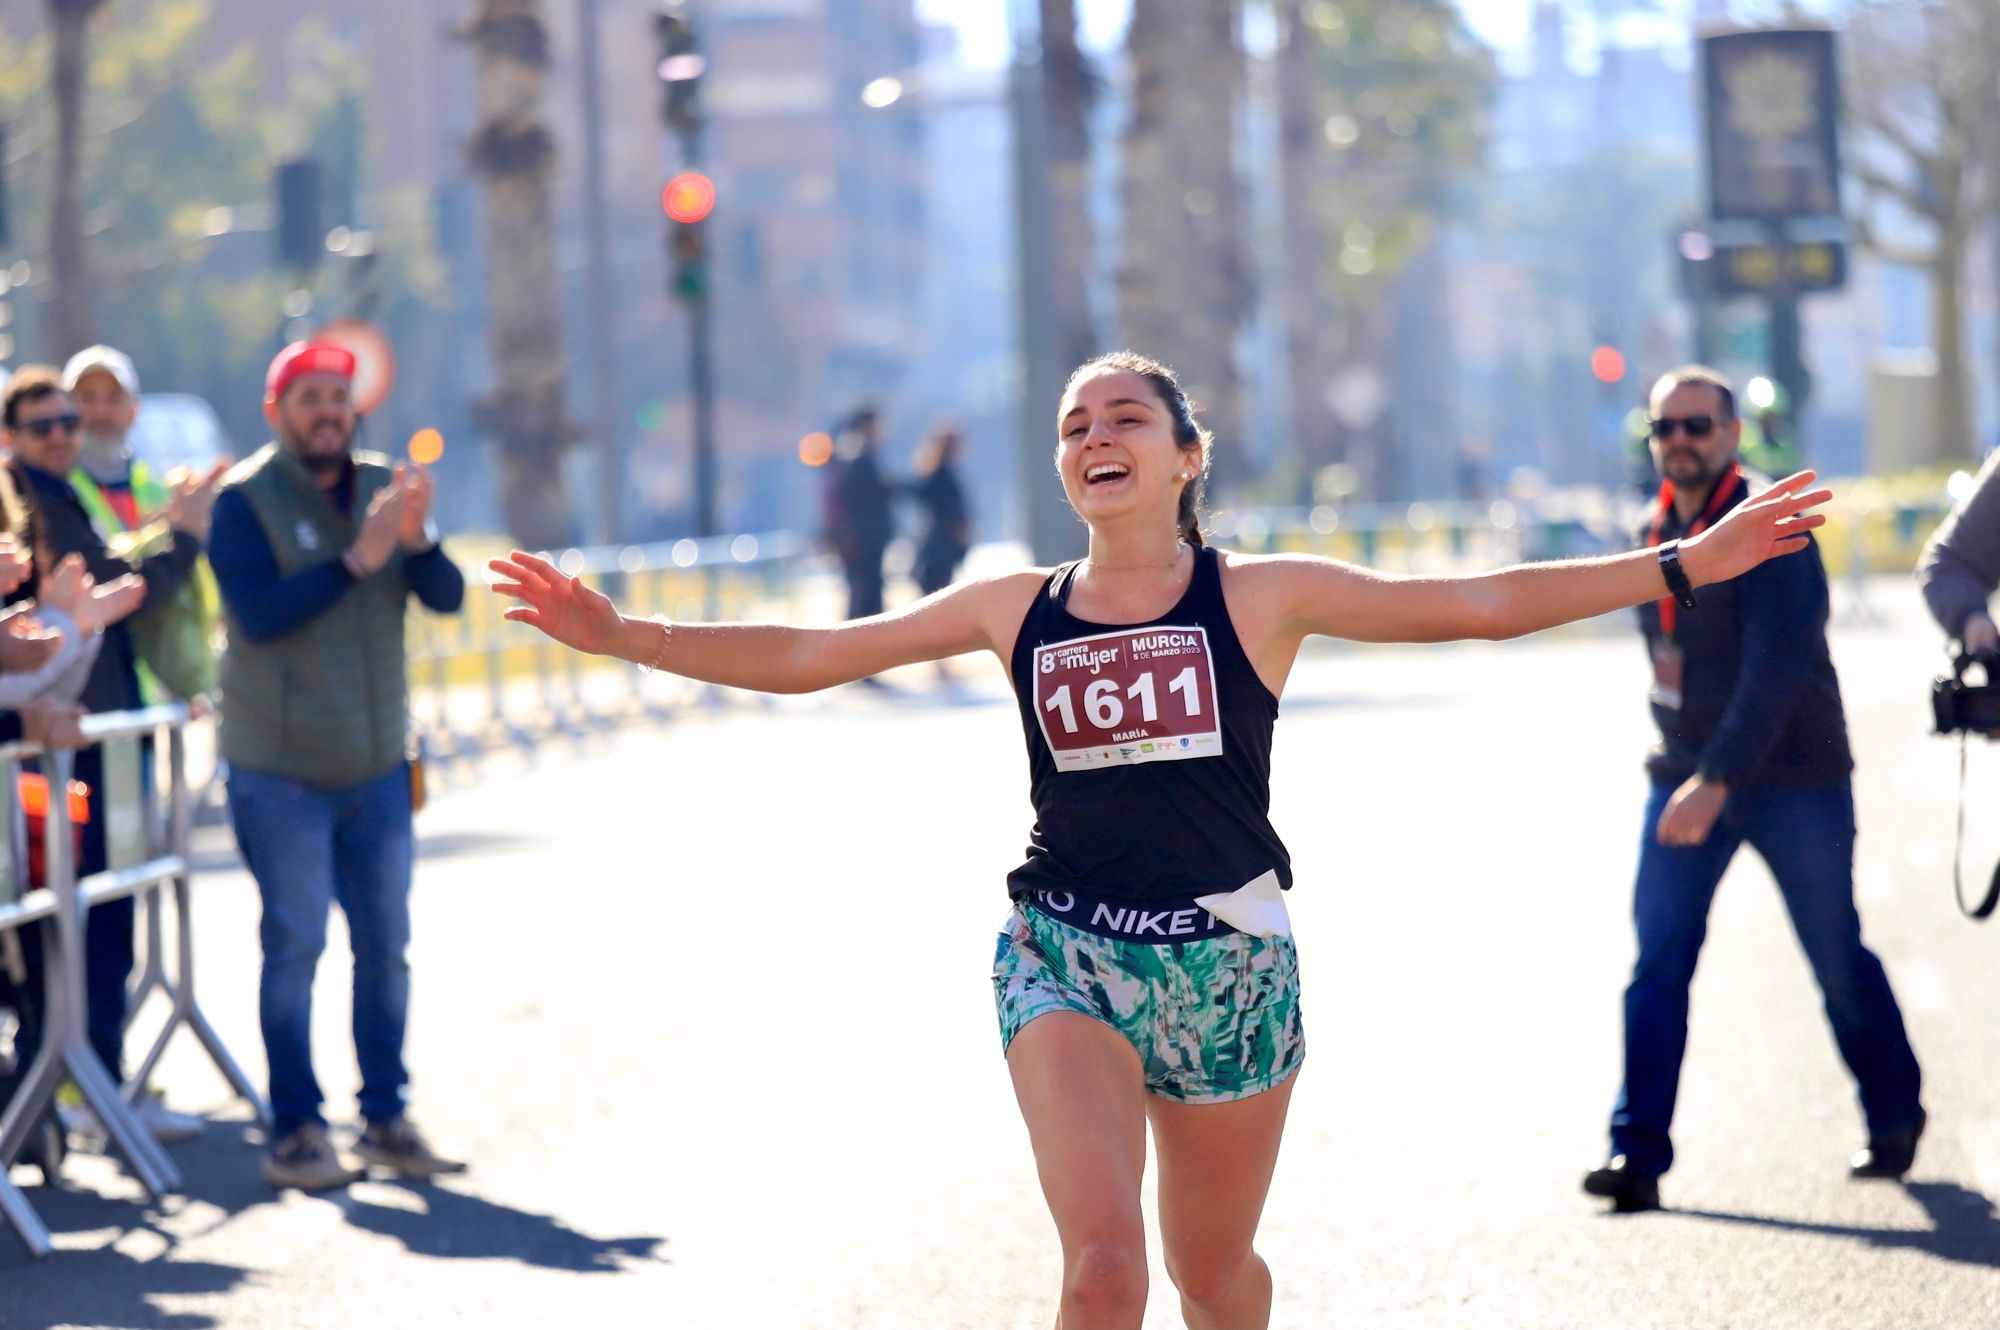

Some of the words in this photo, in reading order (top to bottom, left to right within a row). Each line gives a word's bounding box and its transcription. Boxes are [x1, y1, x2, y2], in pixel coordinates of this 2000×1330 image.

[1057, 645, 1088, 657] carrera
[1132, 635, 1197, 652] MURCIA
[1066, 648, 1118, 675] mujer
[1140, 652, 1150, 660] DE
[1151, 649, 1180, 658] MARZO
[1181, 646, 1200, 655] 2023
[1045, 667, 1200, 733] 1611
[1112, 729, 1148, 742] MARÍA
[1090, 903, 1198, 936] NIKE
